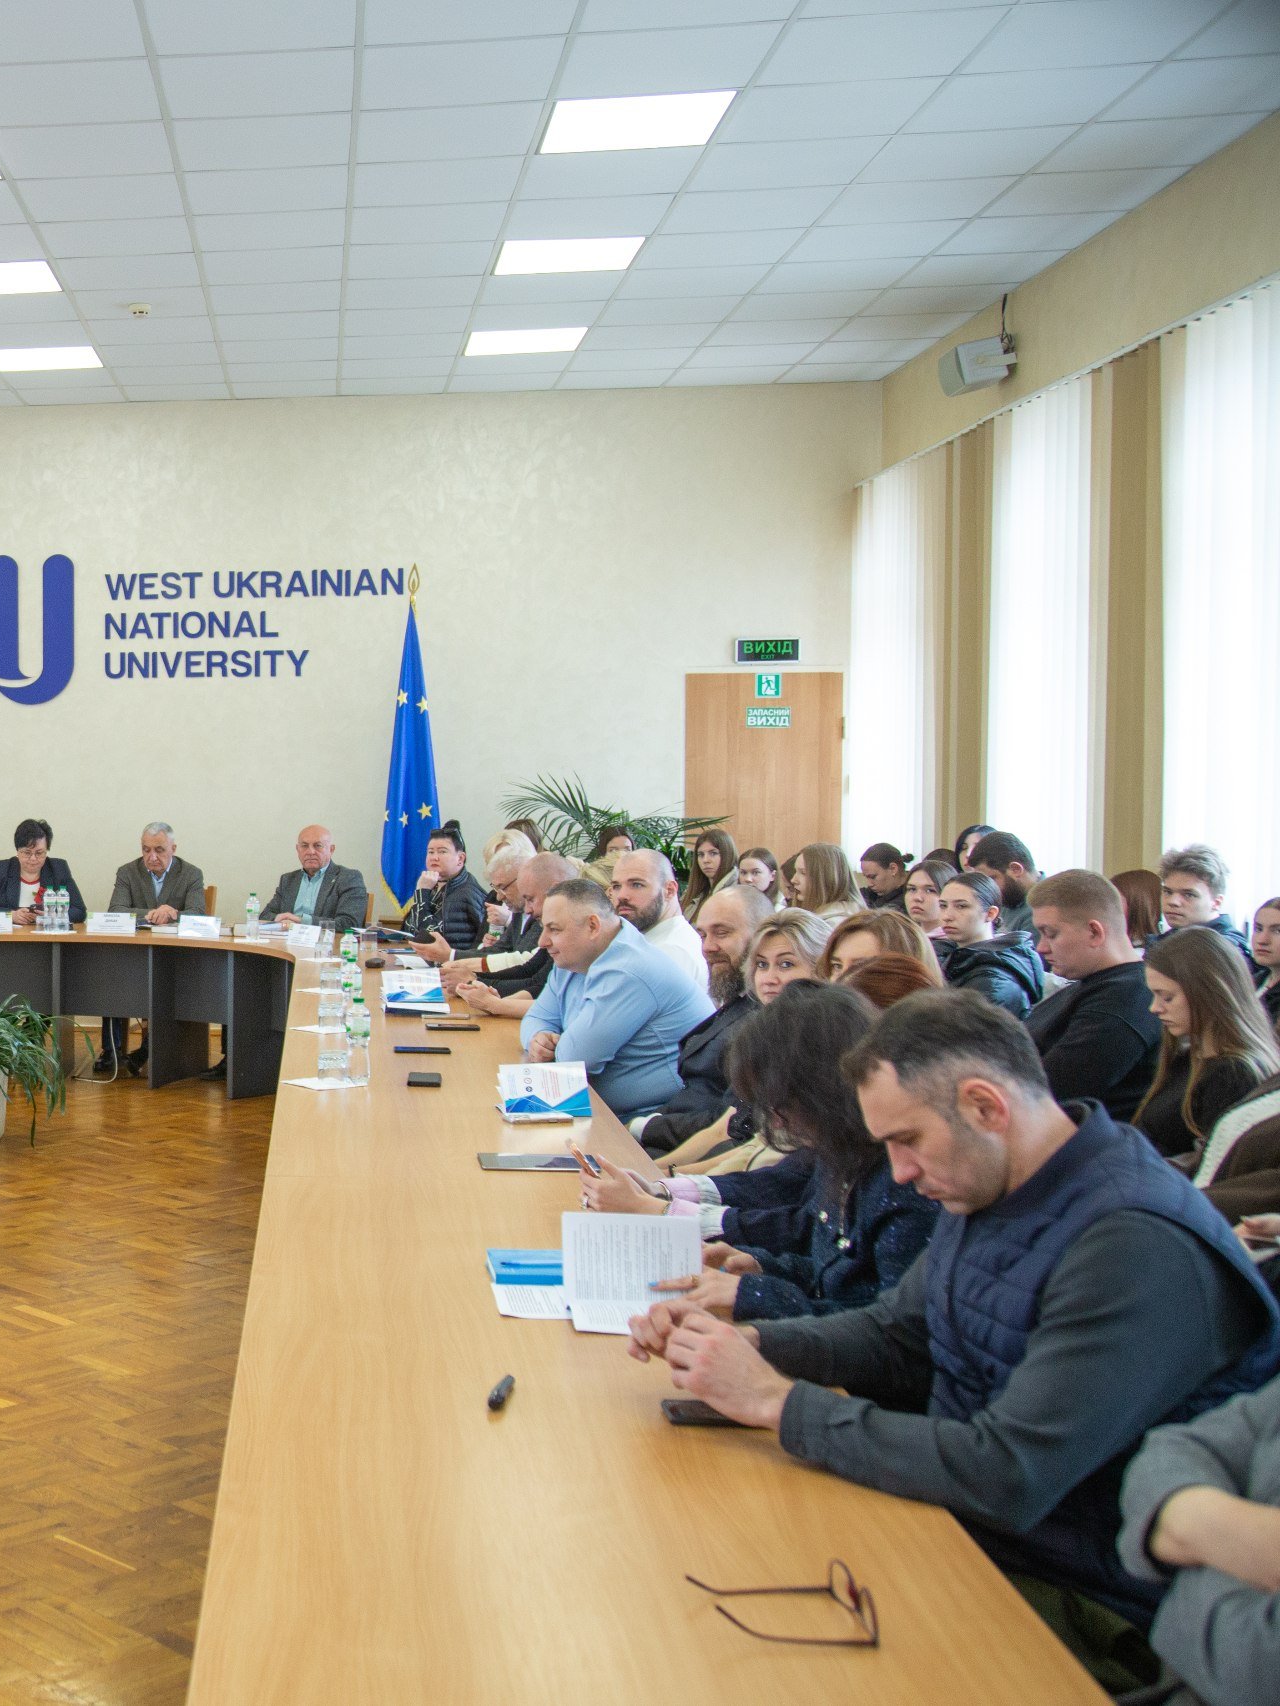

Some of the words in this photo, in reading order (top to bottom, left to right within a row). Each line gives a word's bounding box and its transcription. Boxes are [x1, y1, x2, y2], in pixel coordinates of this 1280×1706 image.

[104, 572, 203, 601] WEST
[213, 567, 404, 599] UKRAINIAN
[104, 610, 279, 640] NATIONAL
[743, 641, 793, 655] ВИХІД
[104, 649, 310, 679] UNIVERSITY
[747, 716, 790, 727] ВИХІД
